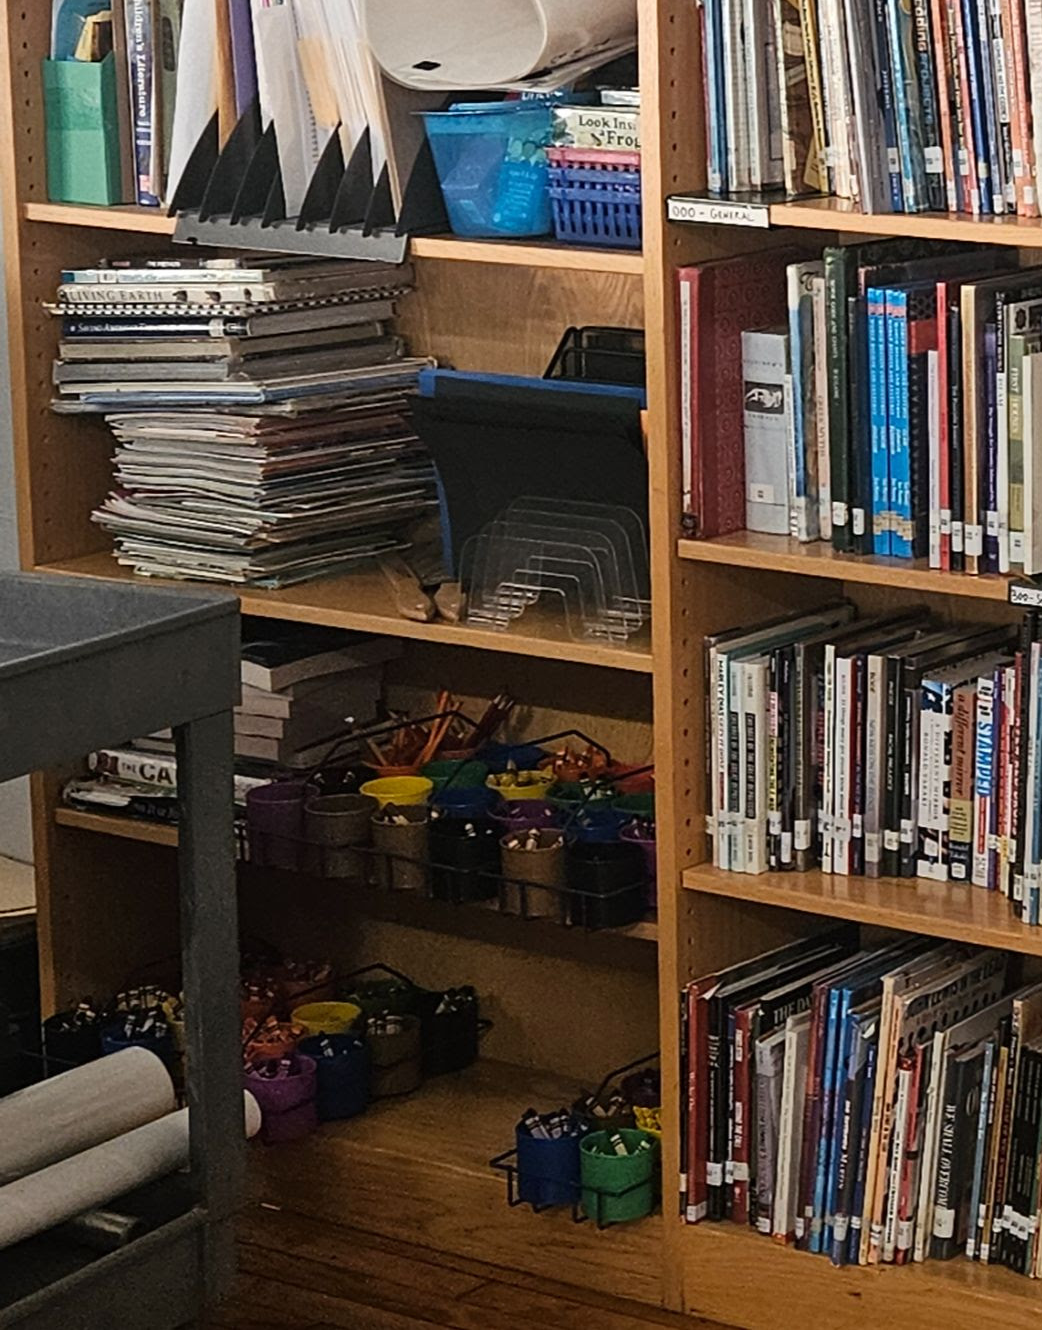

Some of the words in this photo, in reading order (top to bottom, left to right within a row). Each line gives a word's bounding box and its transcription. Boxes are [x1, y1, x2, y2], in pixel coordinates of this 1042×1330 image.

[136, 54, 147, 117] Literature
[579, 115, 610, 127] Look
[672, 206, 695, 218] 000
[69, 291, 115, 301] LIVING
[120, 291, 164, 301] EARTH
[954, 704, 968, 754] different
[954, 756, 966, 796] mirror
[937, 1159, 952, 1208] OVERCOM
